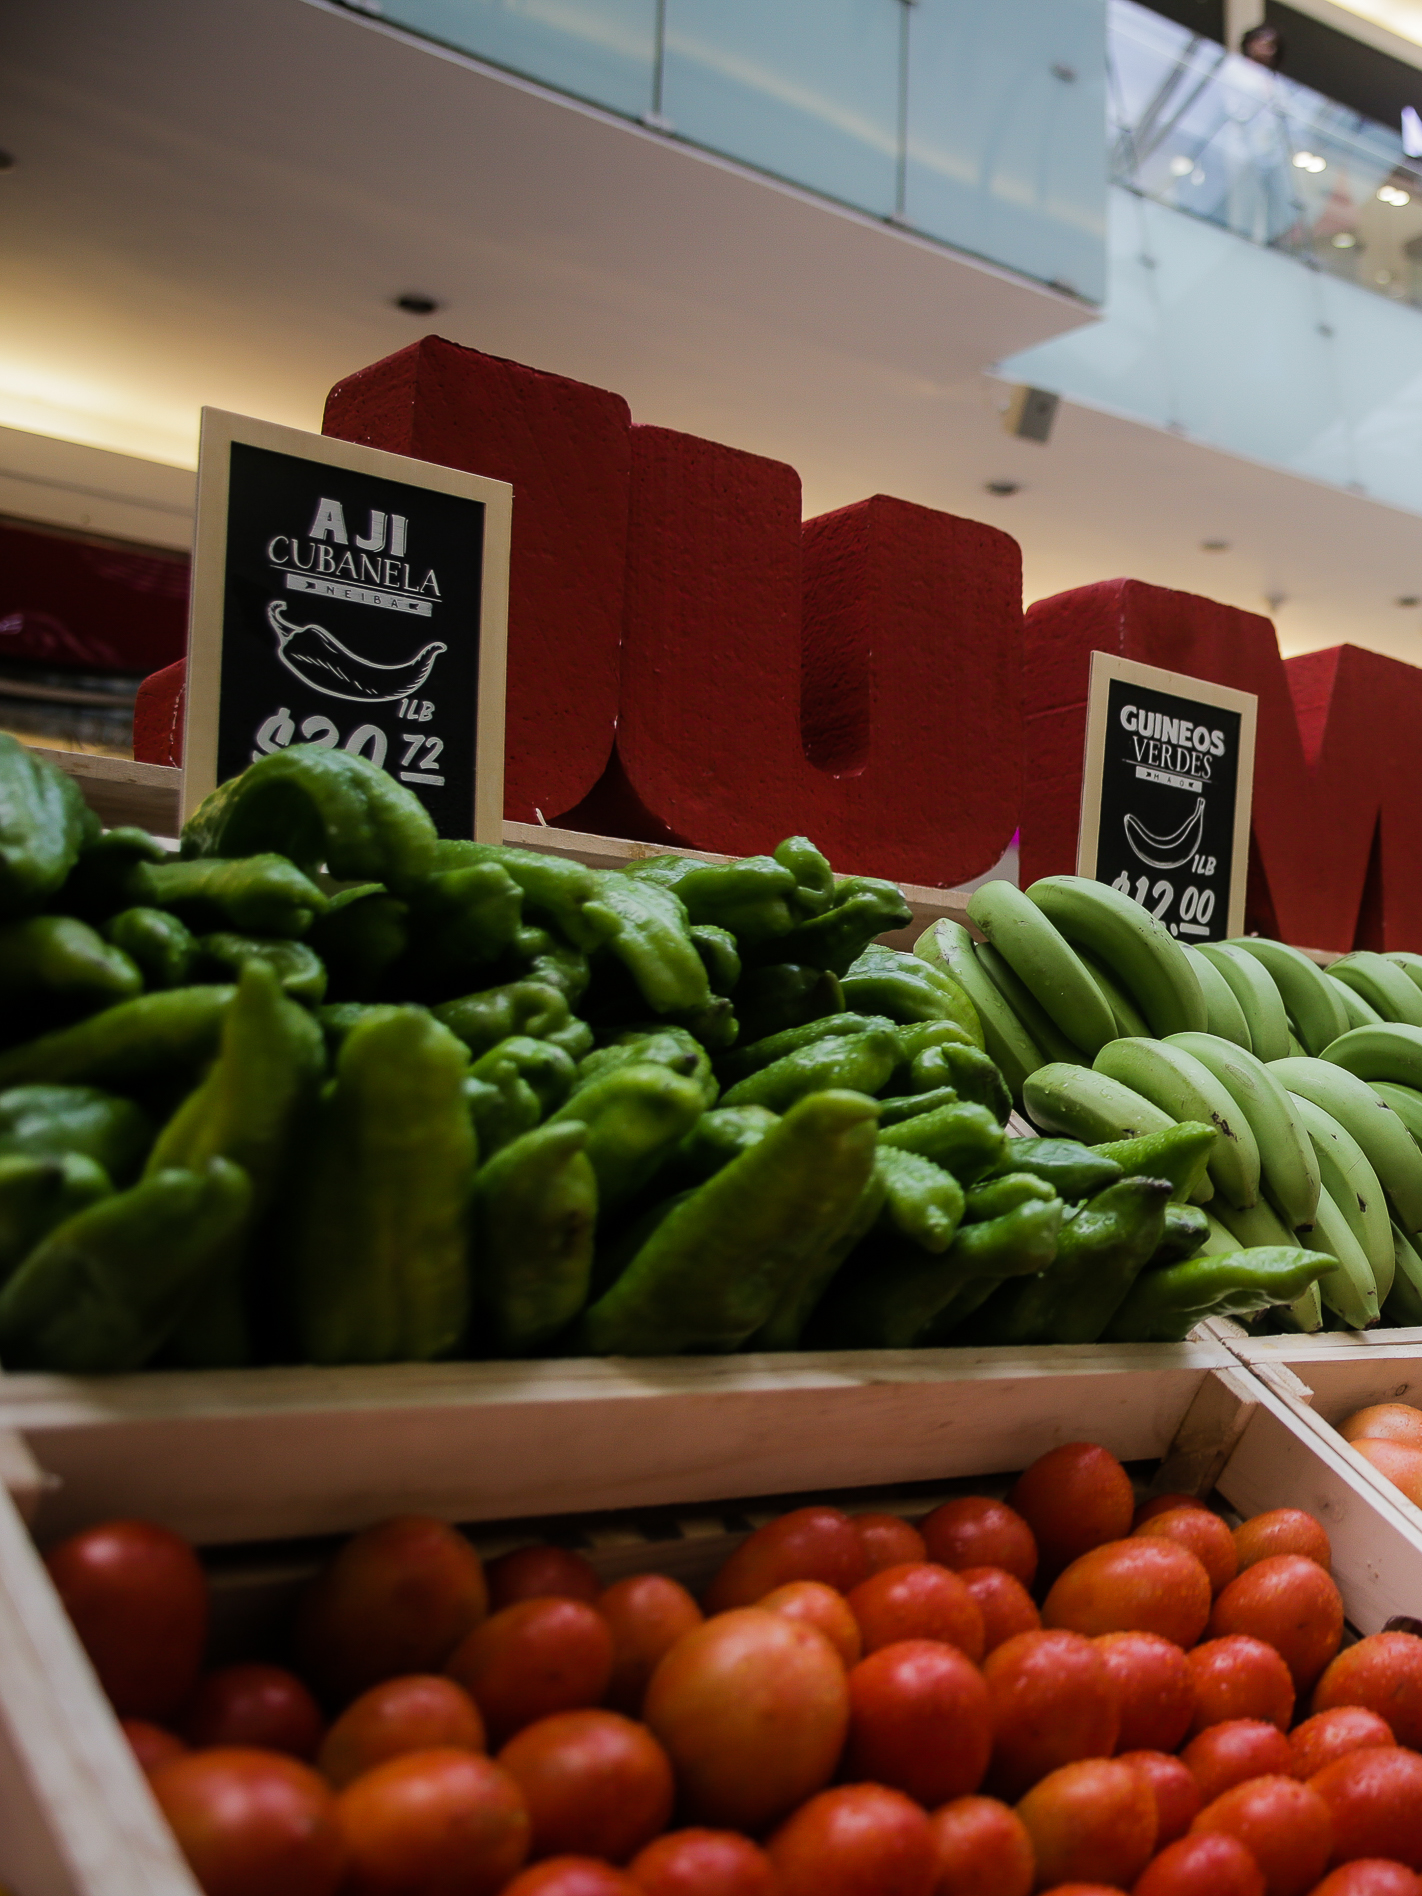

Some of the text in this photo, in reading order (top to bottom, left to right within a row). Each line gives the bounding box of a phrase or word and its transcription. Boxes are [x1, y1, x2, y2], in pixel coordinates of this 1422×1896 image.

[309, 498, 408, 557] AJI
[268, 535, 441, 597] CUBANELA
[326, 585, 399, 609] NEIBA
[1120, 704, 1226, 757] GUINEOS
[1132, 735, 1213, 780] VERDES
[1153, 773, 1185, 788] MAO
